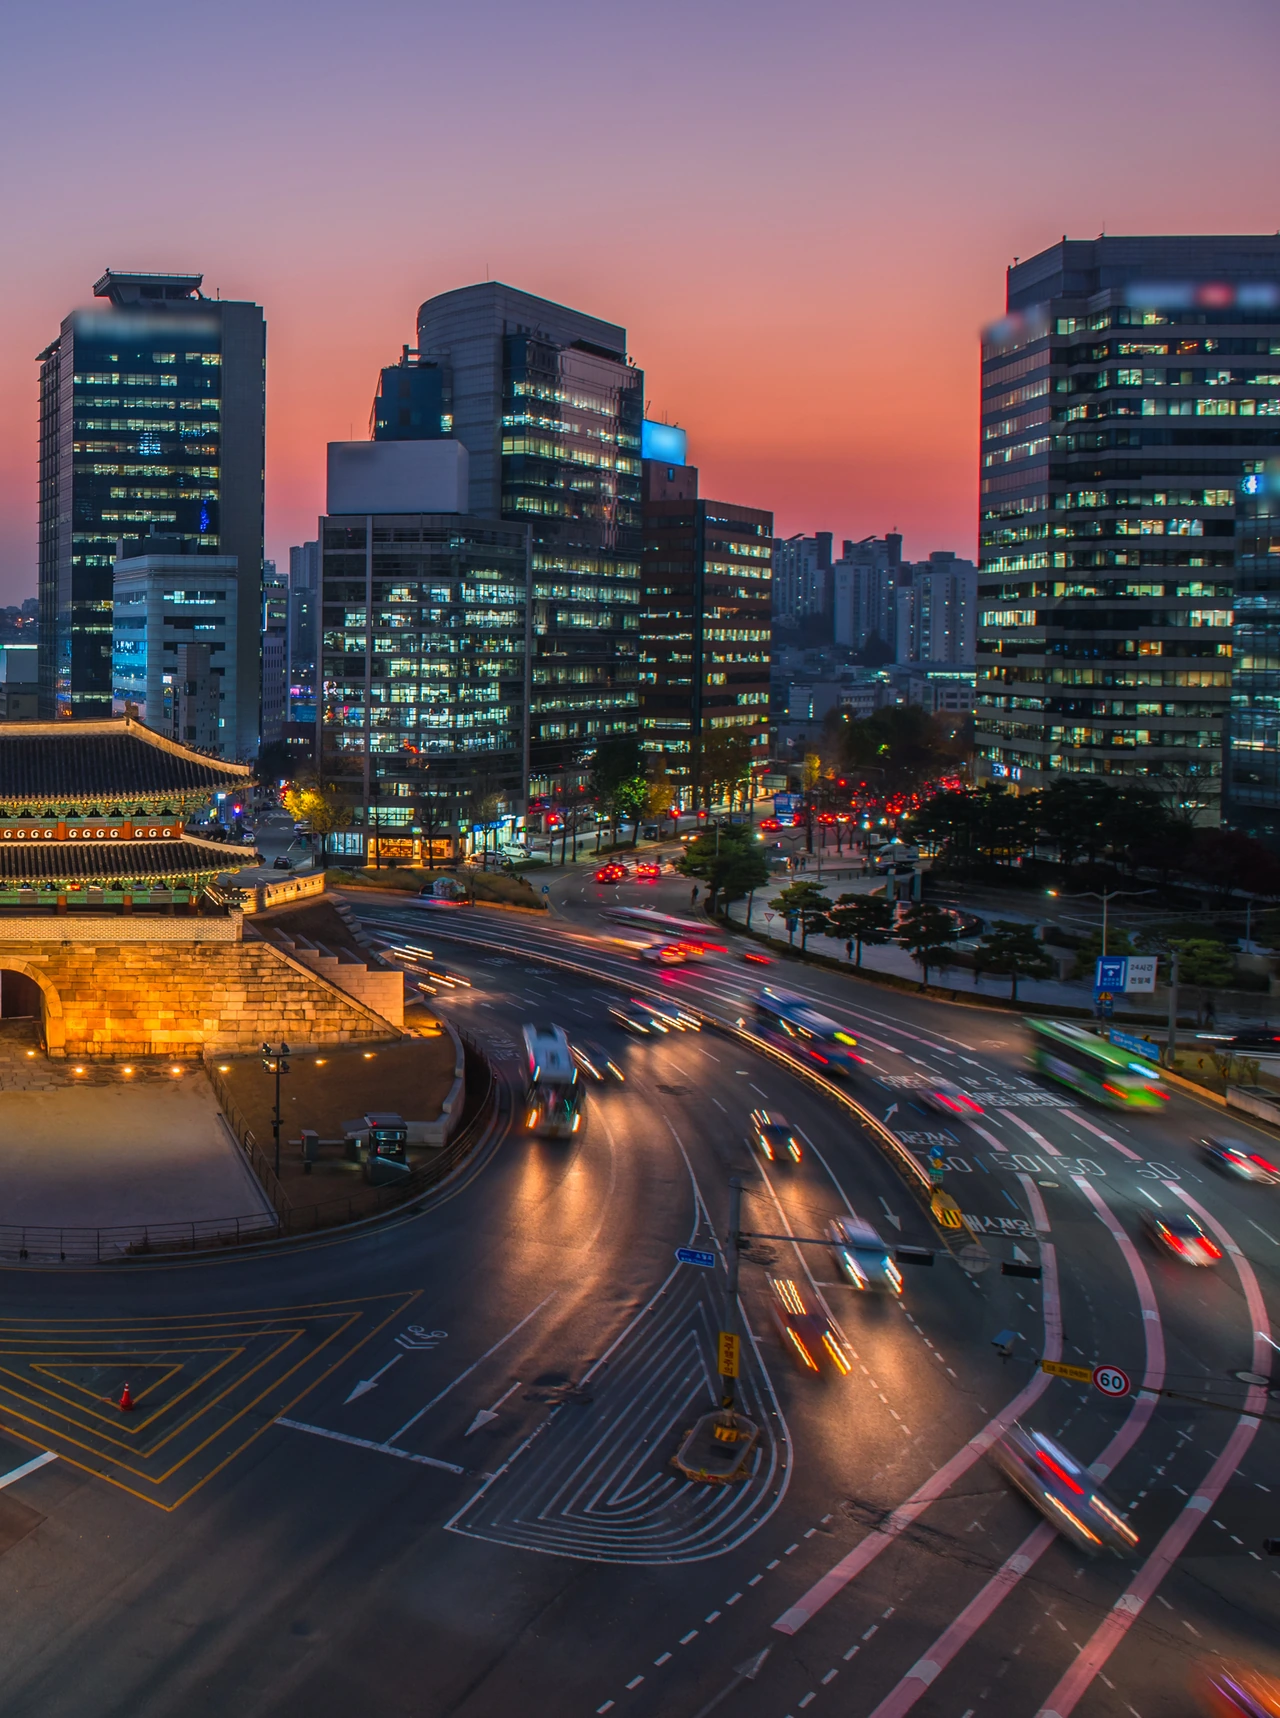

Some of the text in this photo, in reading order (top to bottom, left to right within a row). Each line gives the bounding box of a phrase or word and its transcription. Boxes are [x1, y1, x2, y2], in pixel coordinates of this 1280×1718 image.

[1130, 964, 1154, 972] 24시간
[989, 1152, 1042, 1173] 50
[1053, 1156, 1107, 1177] 50
[1100, 1372, 1123, 1390] 60
